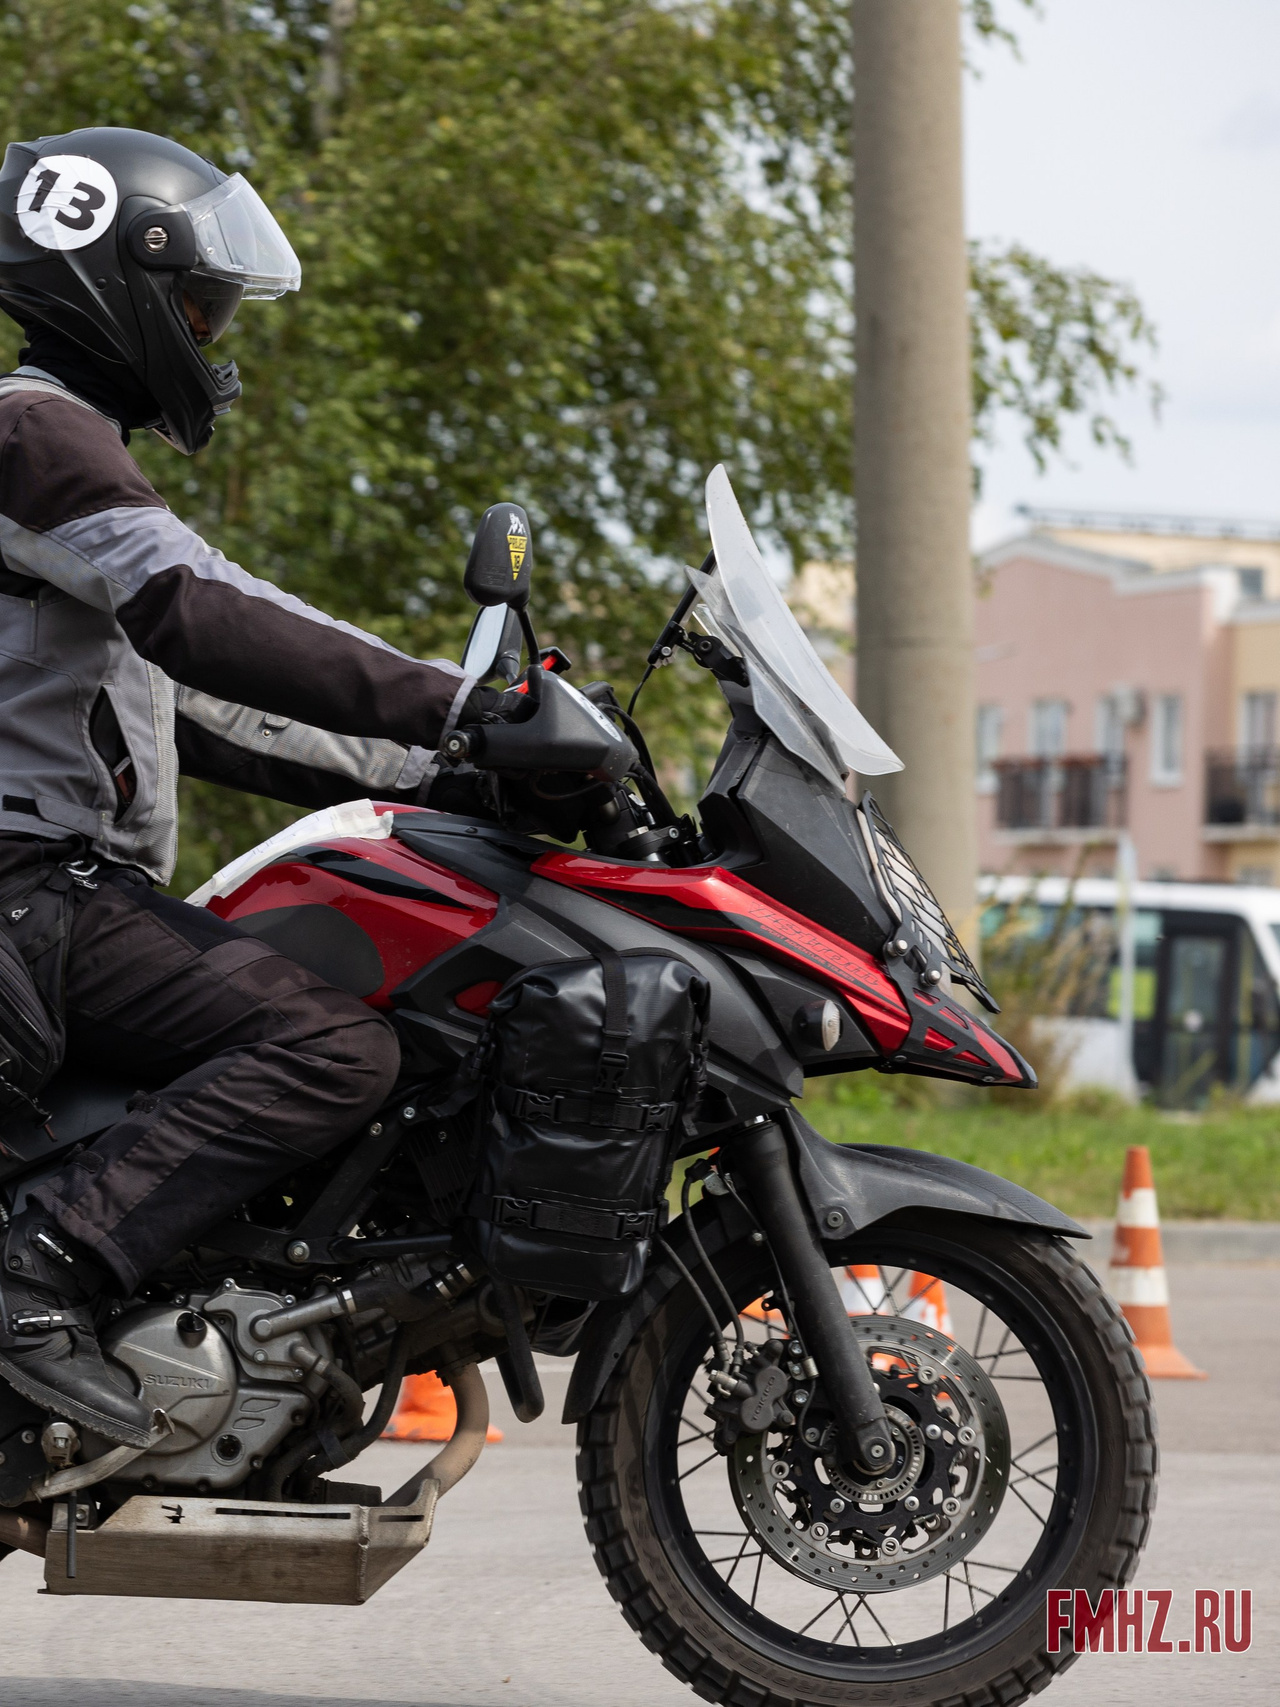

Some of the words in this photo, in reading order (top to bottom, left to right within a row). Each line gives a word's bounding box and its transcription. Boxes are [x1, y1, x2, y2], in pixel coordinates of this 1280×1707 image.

[28, 168, 106, 231] 13
[759, 924, 785, 940] SPORT
[784, 937, 827, 964] ADVENTURE
[143, 1373, 209, 1390] SUZUKI
